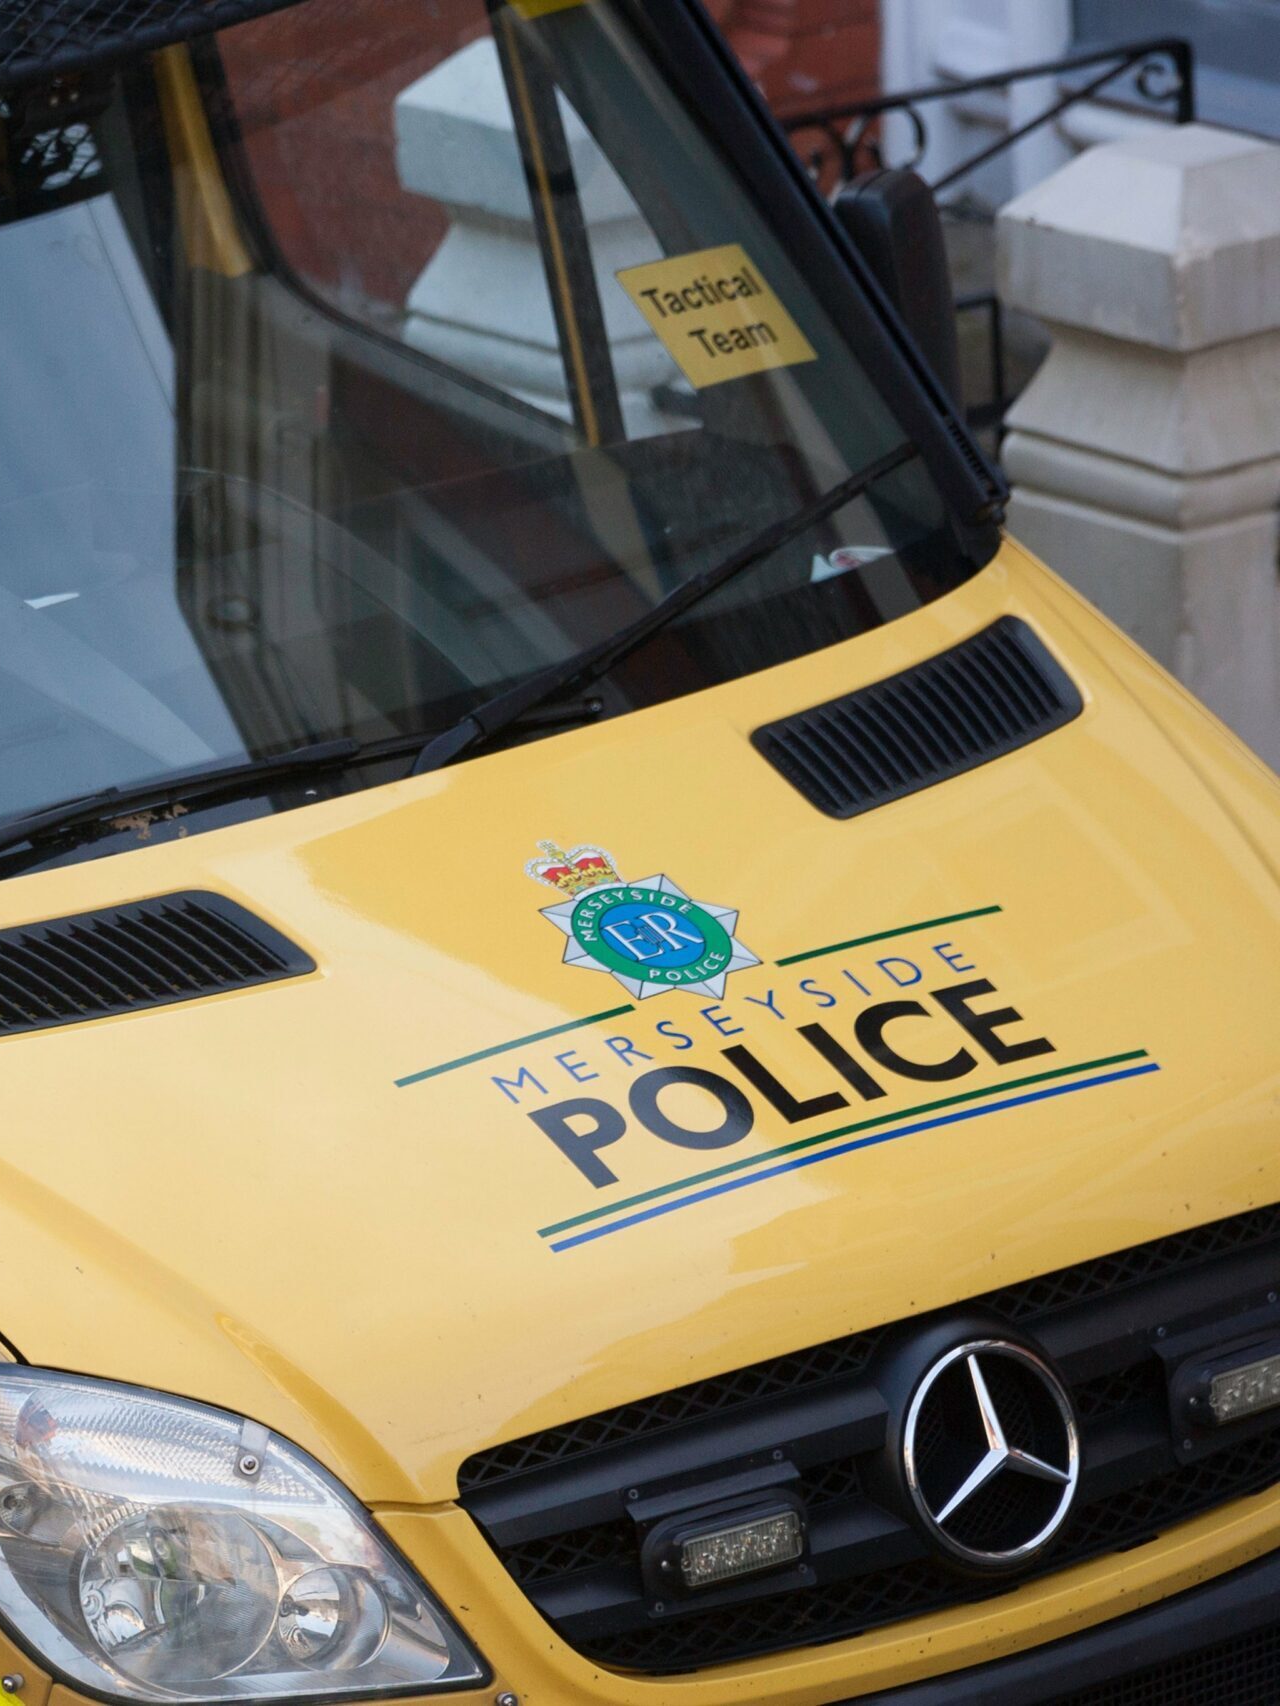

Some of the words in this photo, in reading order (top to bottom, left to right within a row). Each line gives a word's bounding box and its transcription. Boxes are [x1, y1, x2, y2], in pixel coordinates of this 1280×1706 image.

[640, 266, 762, 318] Tactical
[688, 320, 779, 358] Team
[577, 889, 694, 942] MERSEYSIDE
[648, 951, 726, 982] POLICE
[491, 942, 976, 1104] MERSEYSIDE
[527, 978, 1057, 1189] POLICE
